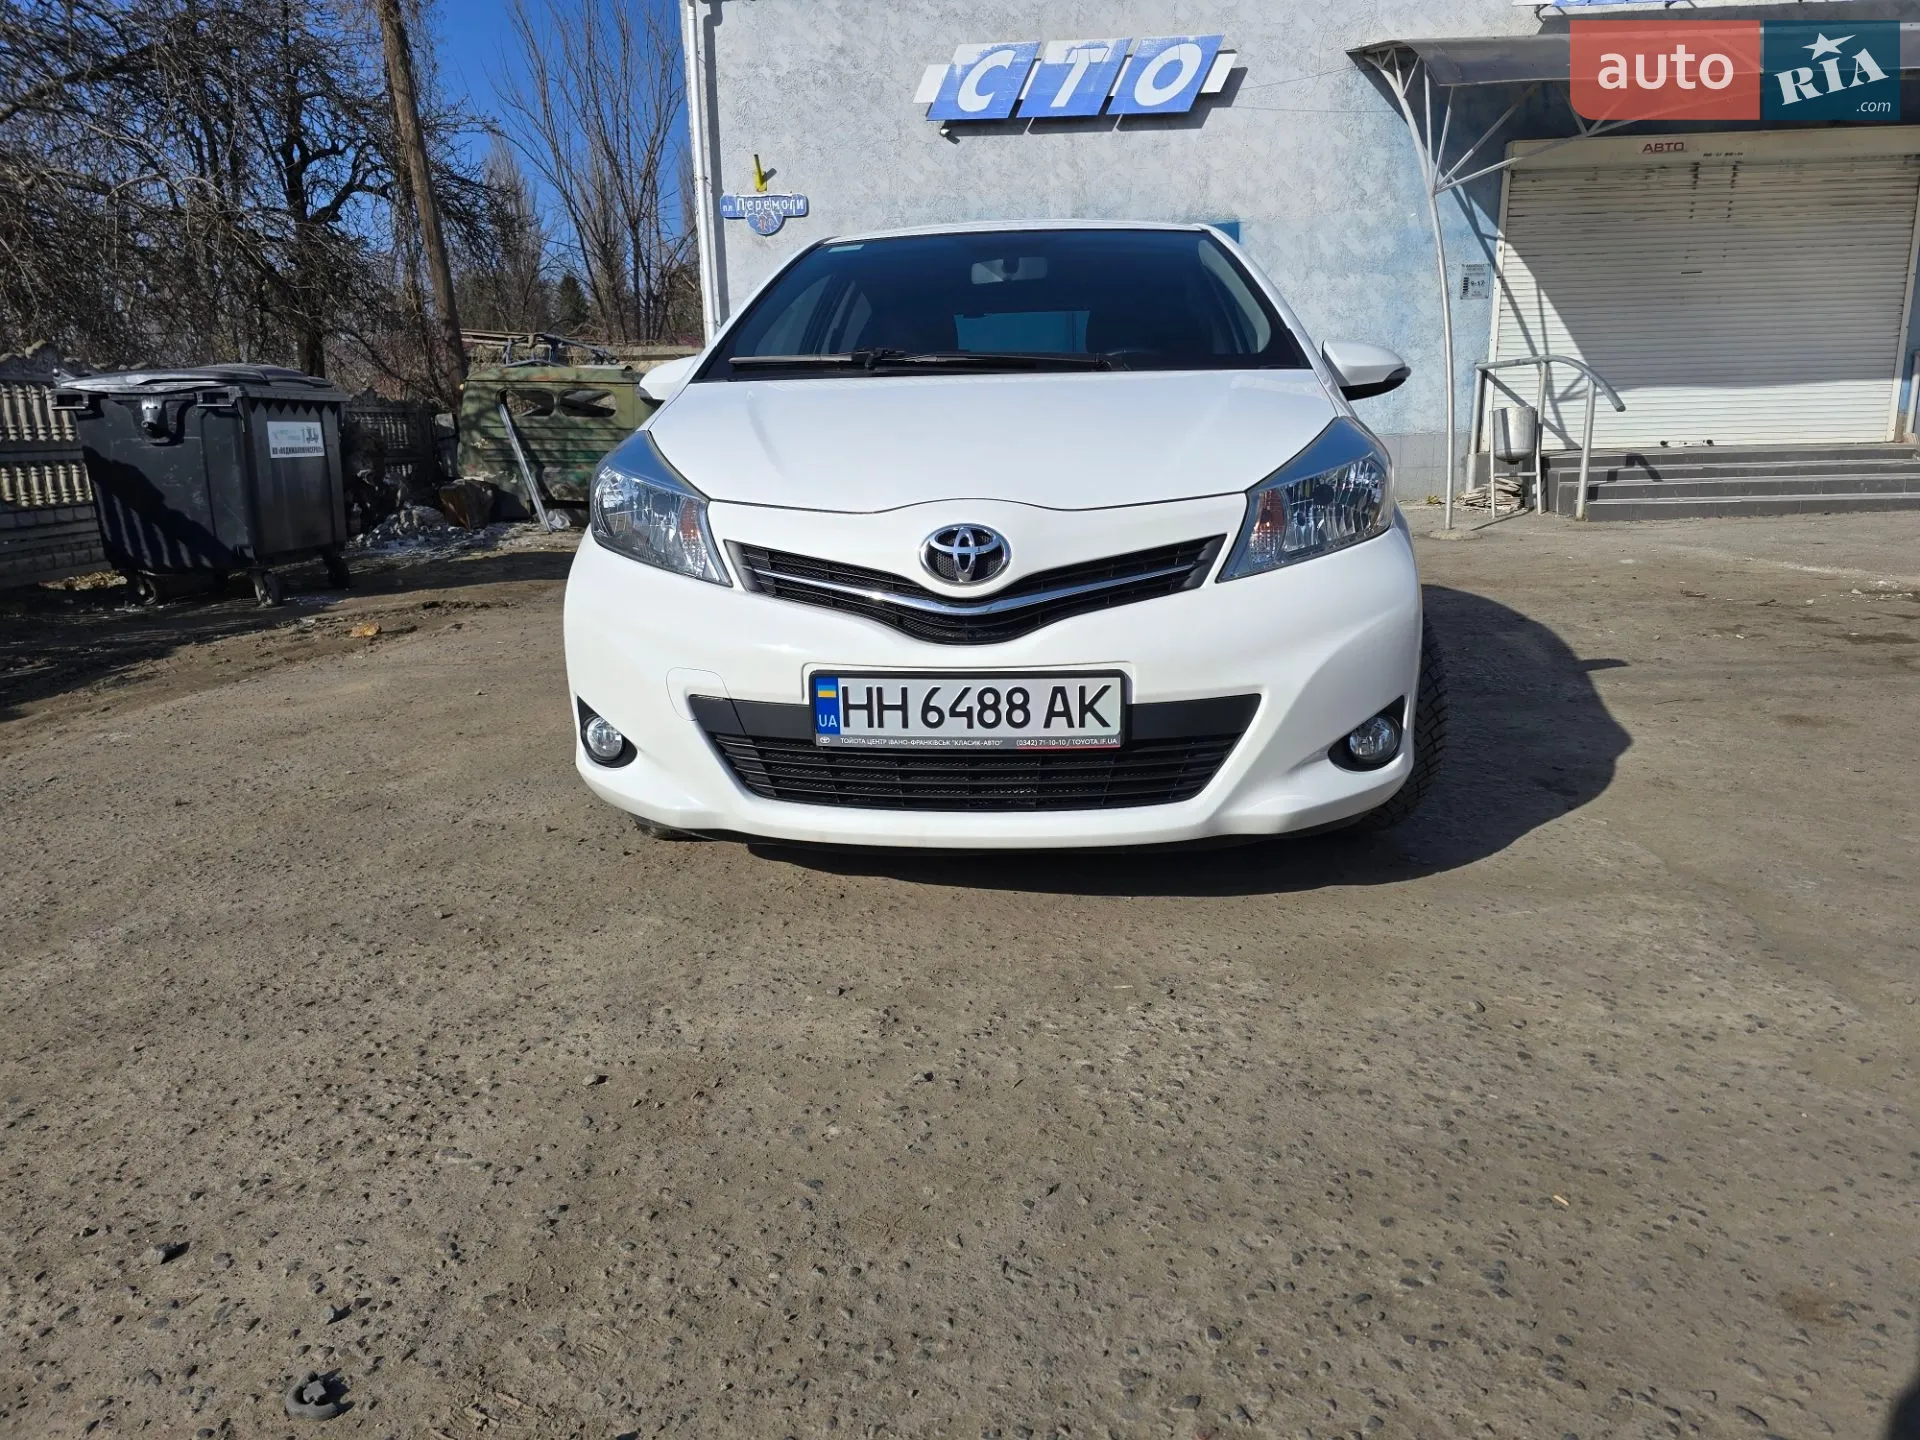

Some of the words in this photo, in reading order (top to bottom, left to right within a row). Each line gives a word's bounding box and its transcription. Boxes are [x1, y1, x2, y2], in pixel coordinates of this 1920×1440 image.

[957, 43, 1202, 112] СТО
[1642, 142, 1685, 153] АВТО
[736, 198, 804, 213] Перемоги
[841, 685, 909, 729] HH
[921, 686, 1031, 729] 6488
[1043, 684, 1112, 729] AK
[818, 714, 838, 727] UA
[1016, 739, 1037, 747] (0342)
